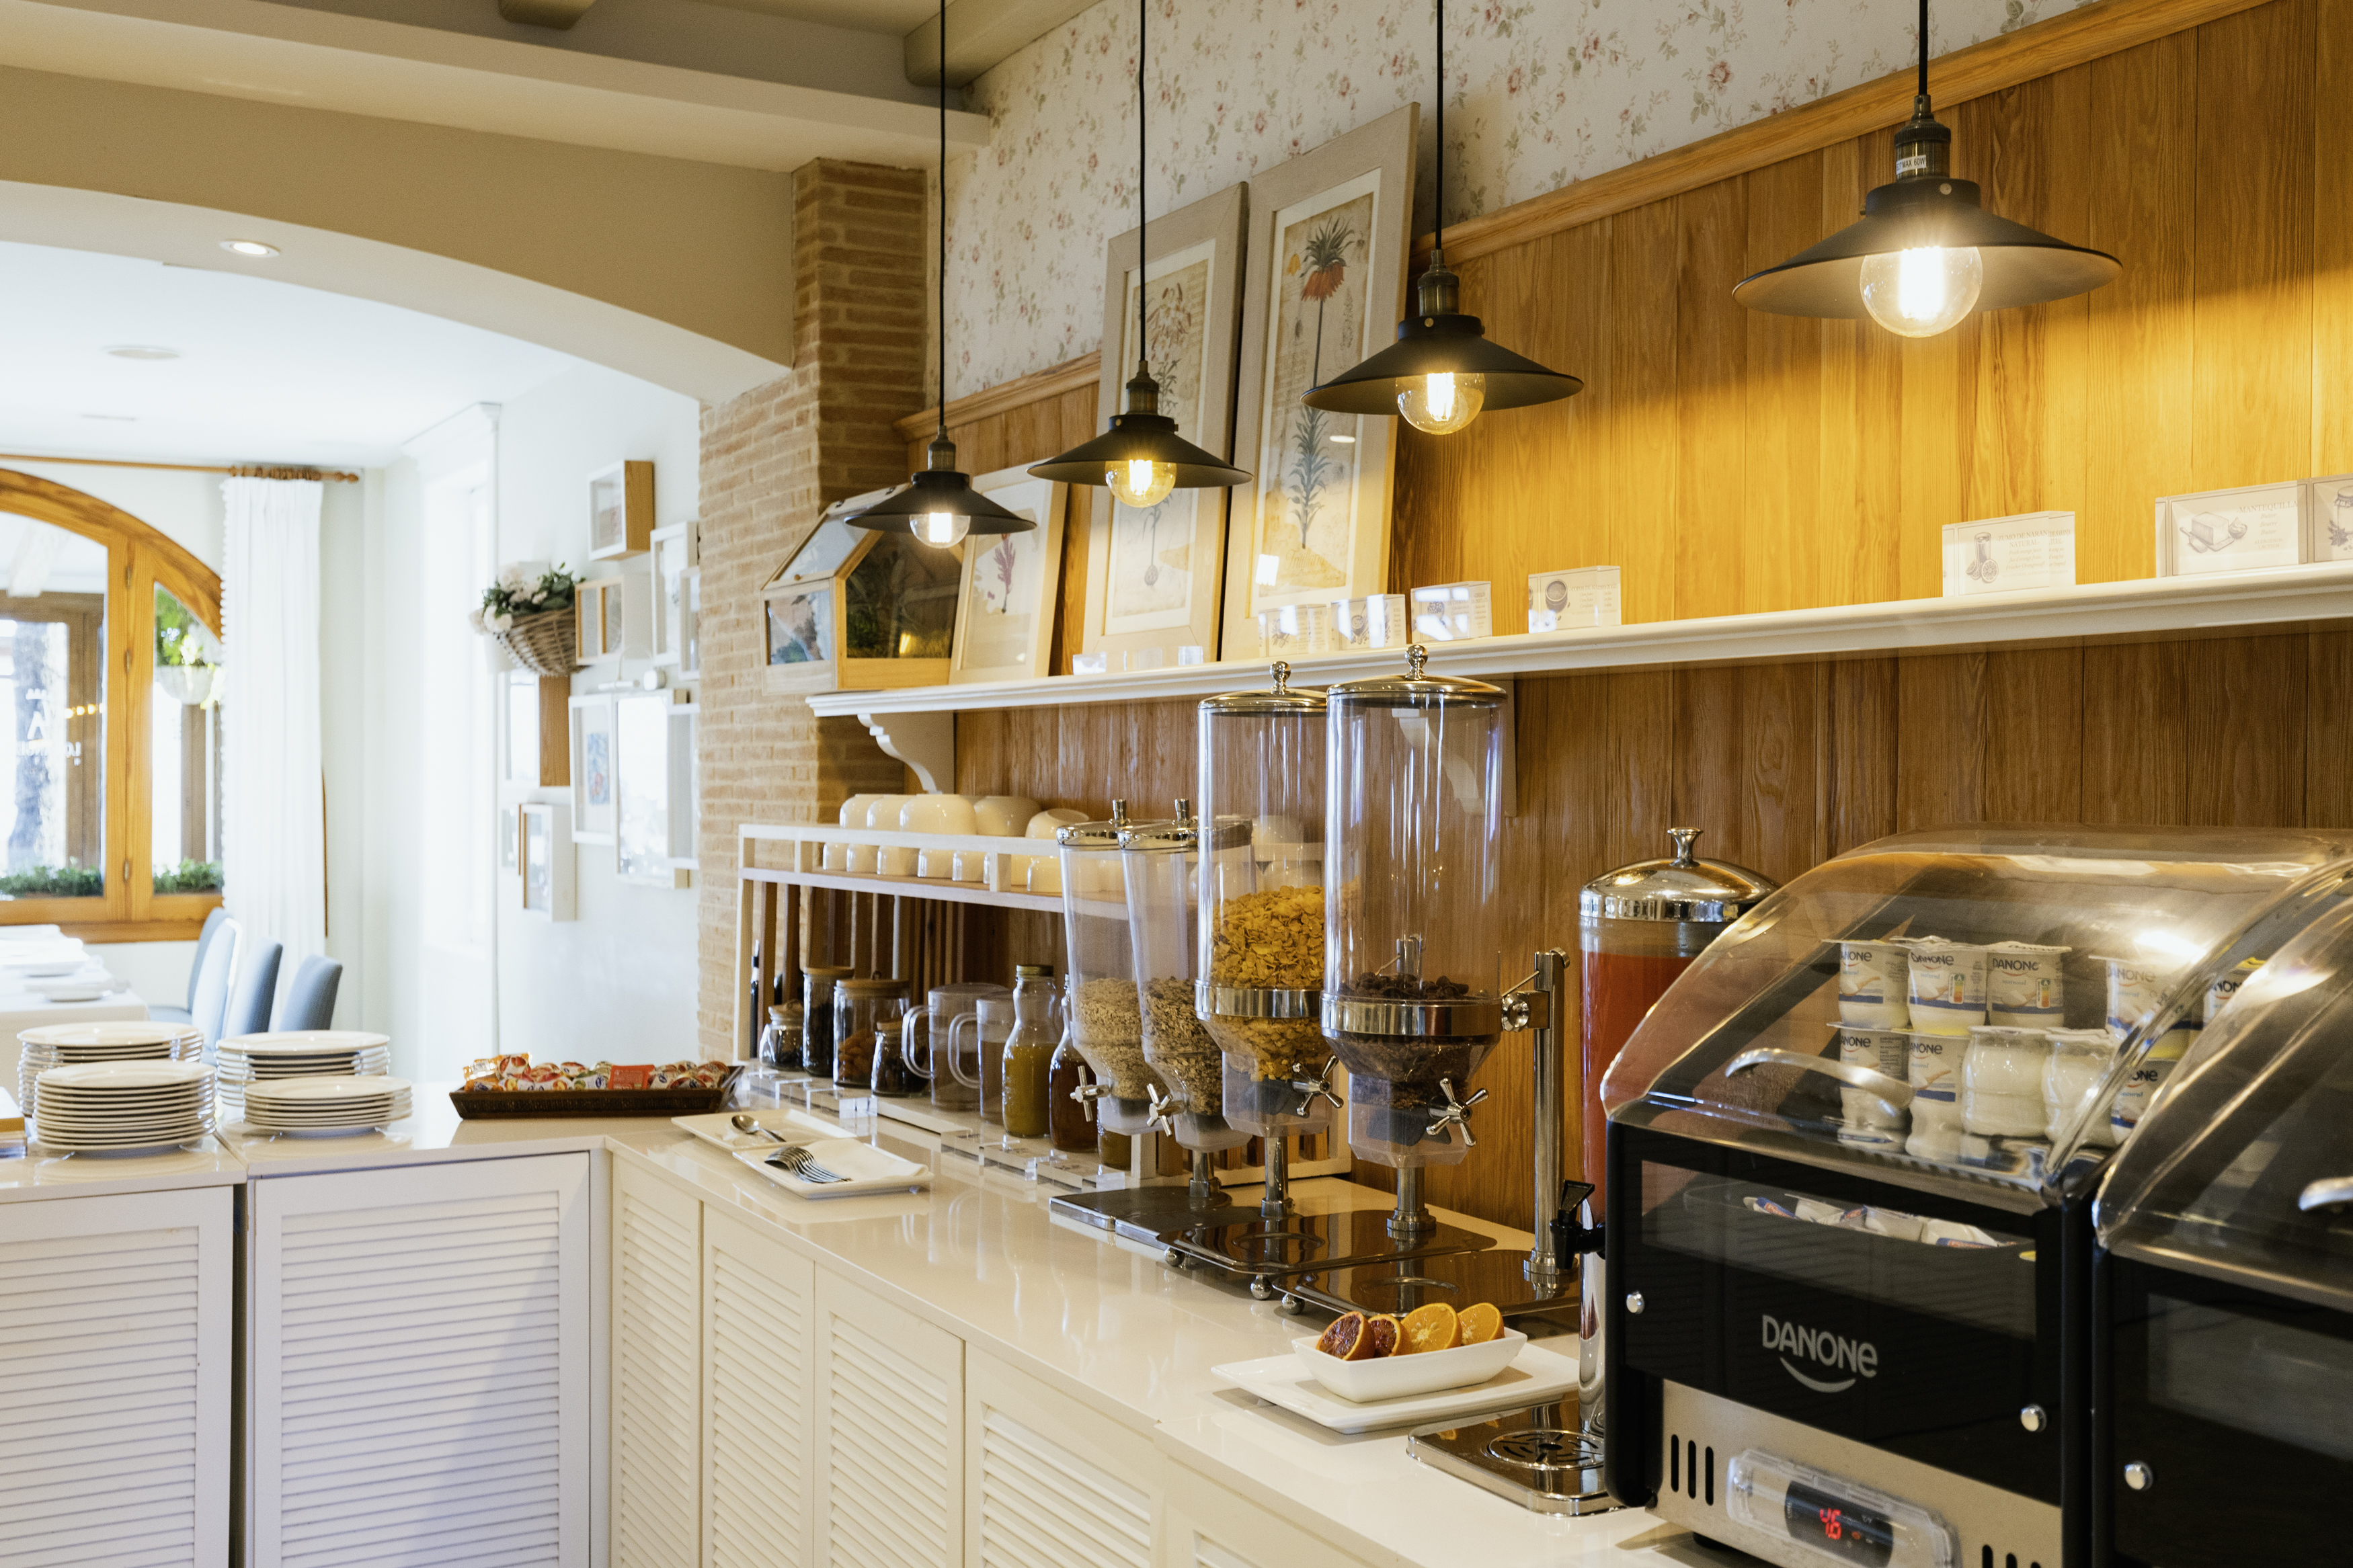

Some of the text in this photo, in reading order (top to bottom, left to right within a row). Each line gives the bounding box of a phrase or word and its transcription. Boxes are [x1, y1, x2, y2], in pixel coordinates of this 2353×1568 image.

[1902, 159, 1912, 167] MAX
[1913, 157, 1925, 166] 60W
[1841, 951, 1872, 962] ANONE
[1841, 1036, 1872, 1048] ANONE
[1910, 1042, 1943, 1055] ANONE
[1762, 1314, 1878, 1378] DANONE
